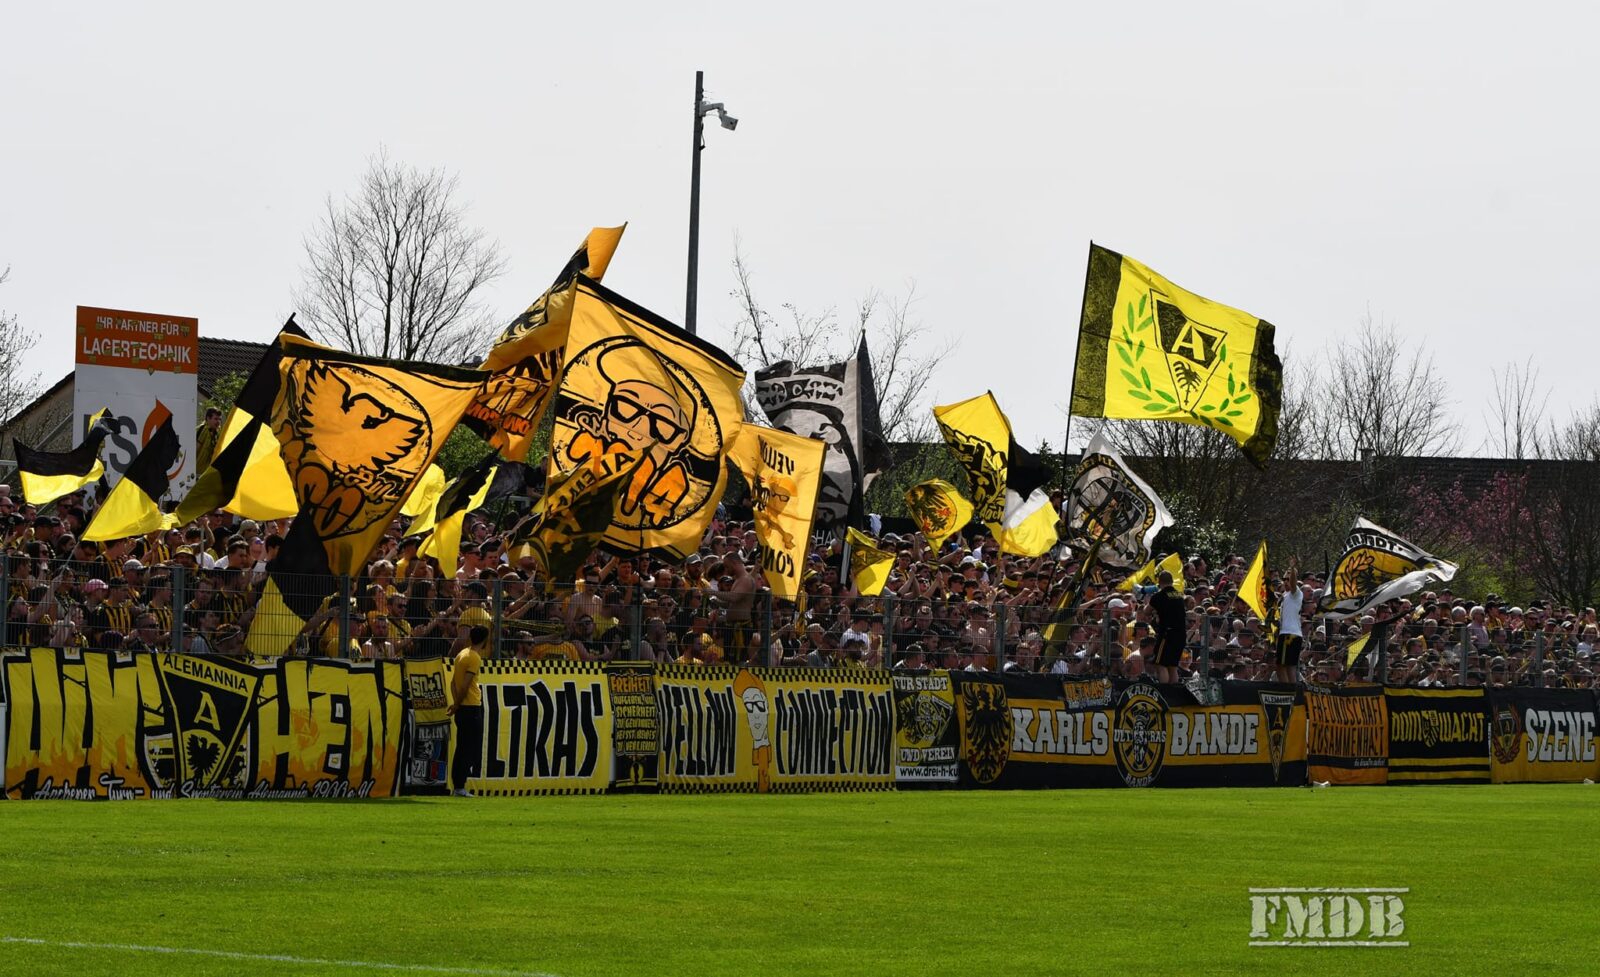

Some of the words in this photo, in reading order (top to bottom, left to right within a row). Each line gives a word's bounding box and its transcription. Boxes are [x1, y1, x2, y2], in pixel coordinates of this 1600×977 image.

[160, 321, 180, 336] FÜR
[1171, 321, 1206, 361] A
[83, 336, 192, 364] LAGERTECHNIK
[164, 653, 248, 692] ALEMANNIA
[610, 675, 650, 692] FREIHEIT
[915, 676, 948, 690] STADT
[193, 691, 221, 731] A
[615, 705, 656, 717] SICHERHEIT
[1311, 694, 1383, 725] FREUNDSCHAFT
[467, 680, 603, 778] LTRAS
[658, 685, 736, 776] YELLOW
[775, 688, 893, 775] CONNECTION
[1011, 707, 1109, 756] KARLS
[1170, 712, 1259, 756] BANDE
[1311, 722, 1384, 756] ZUSAMMENHALT
[1525, 707, 1596, 762] SZENE
[900, 748, 920, 762] UND
